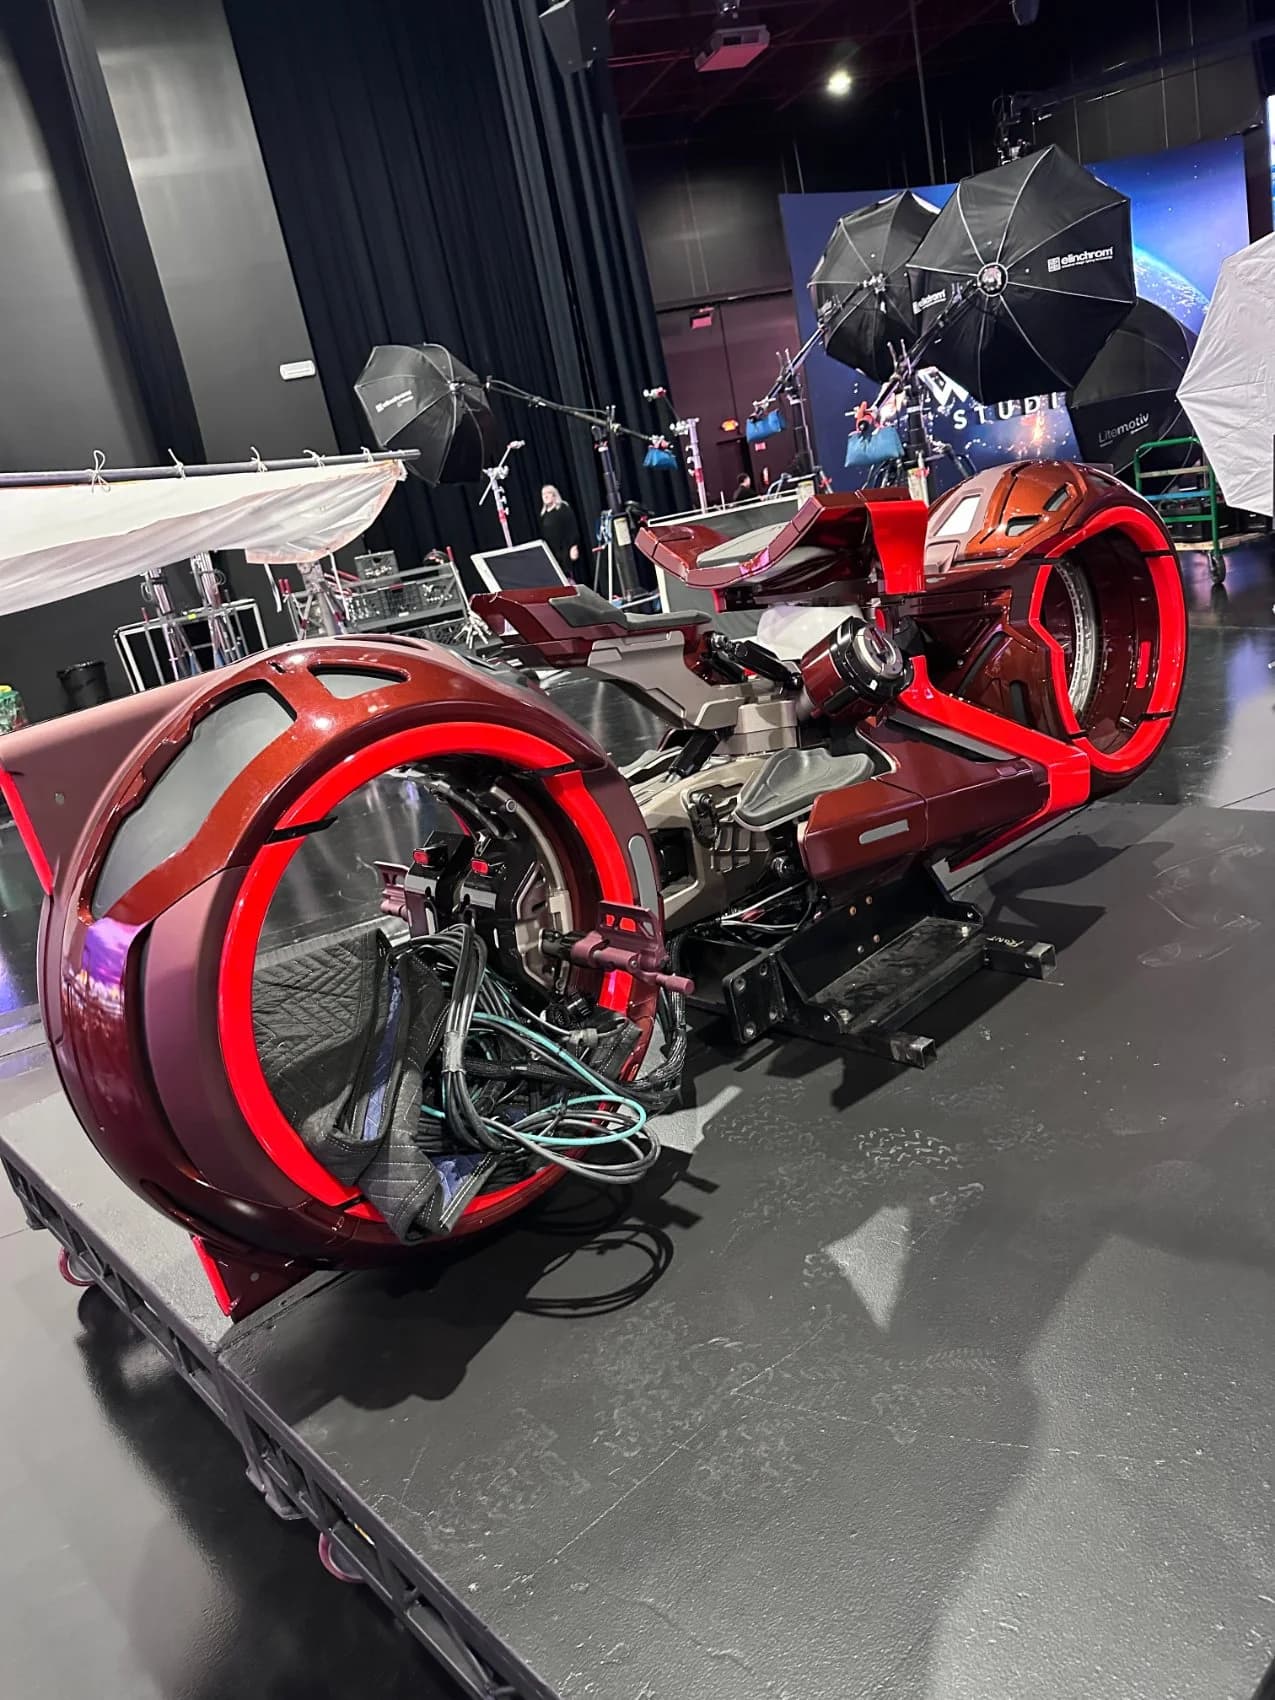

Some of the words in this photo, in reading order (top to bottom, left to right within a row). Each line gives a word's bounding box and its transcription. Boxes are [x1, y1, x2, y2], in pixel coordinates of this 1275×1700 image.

[1061, 247, 1113, 264] elinchrom
[953, 391, 1058, 430] STUDI
[1098, 413, 1149, 443] Litemotiv
